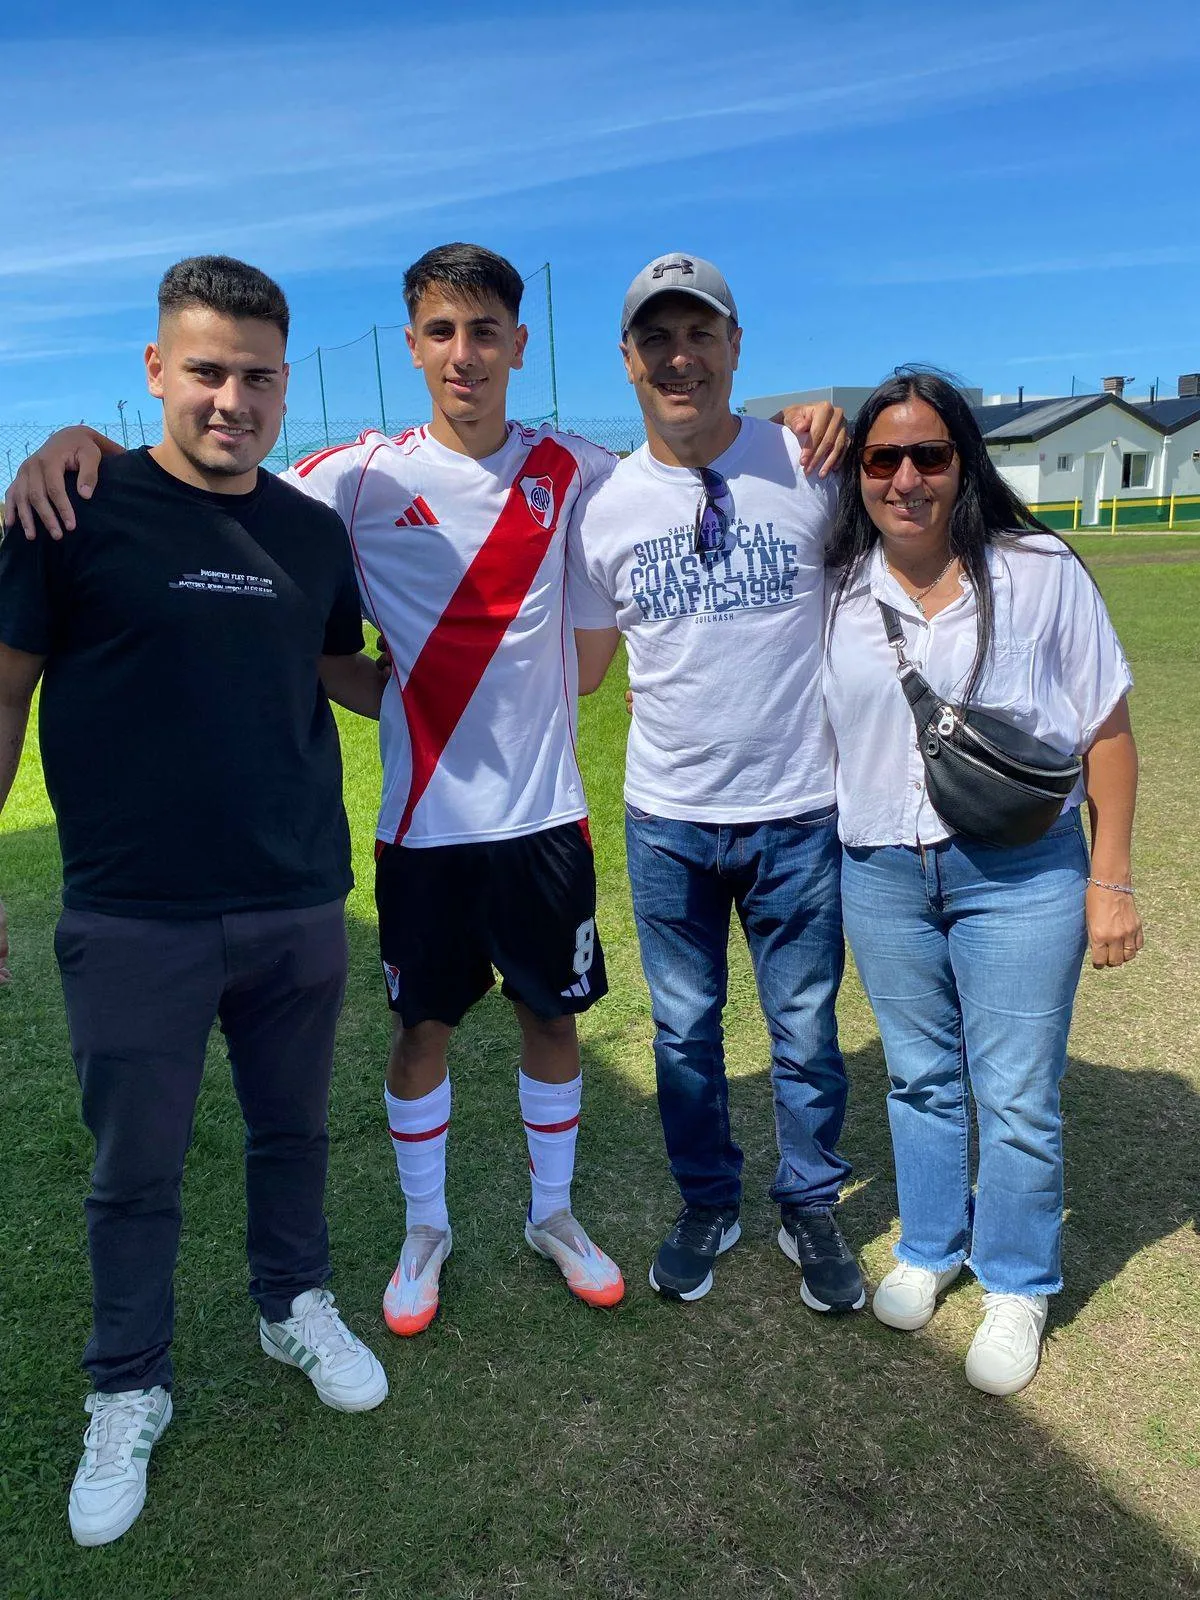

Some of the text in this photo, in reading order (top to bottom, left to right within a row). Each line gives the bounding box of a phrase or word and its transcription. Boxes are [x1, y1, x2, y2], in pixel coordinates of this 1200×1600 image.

[668, 524, 695, 536] SANTA
[736, 522, 786, 549] CAL.
[630, 544, 799, 596] COASTLINE
[632, 582, 728, 620] PACIFIC
[573, 916, 595, 976] 8
